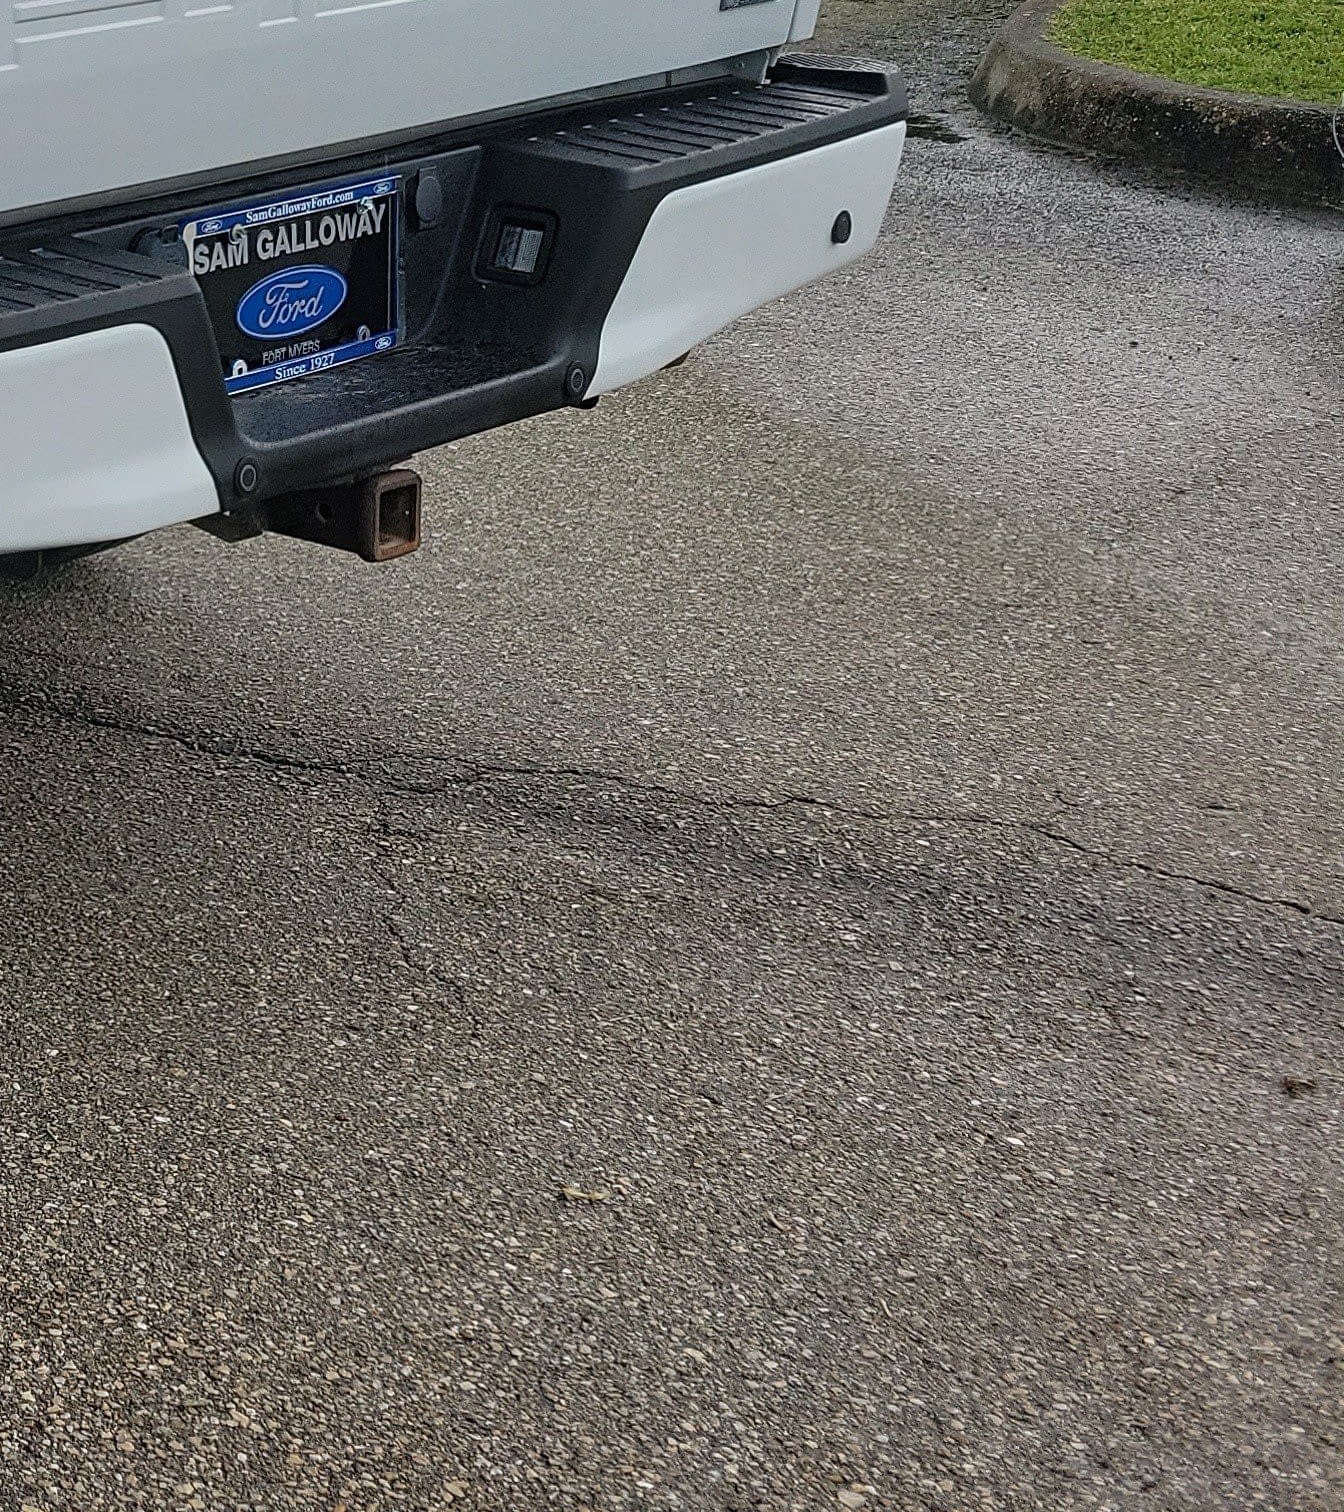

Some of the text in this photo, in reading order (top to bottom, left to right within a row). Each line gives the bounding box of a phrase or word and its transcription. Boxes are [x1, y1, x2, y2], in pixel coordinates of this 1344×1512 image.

[245, 189, 354, 225] SamGallowayFord.com
[193, 202, 387, 276] SAM GALLOWAY
[258, 278, 325, 329] Ford
[261, 339, 321, 366] FORT MYERS
[274, 352, 335, 380] Since 1927
